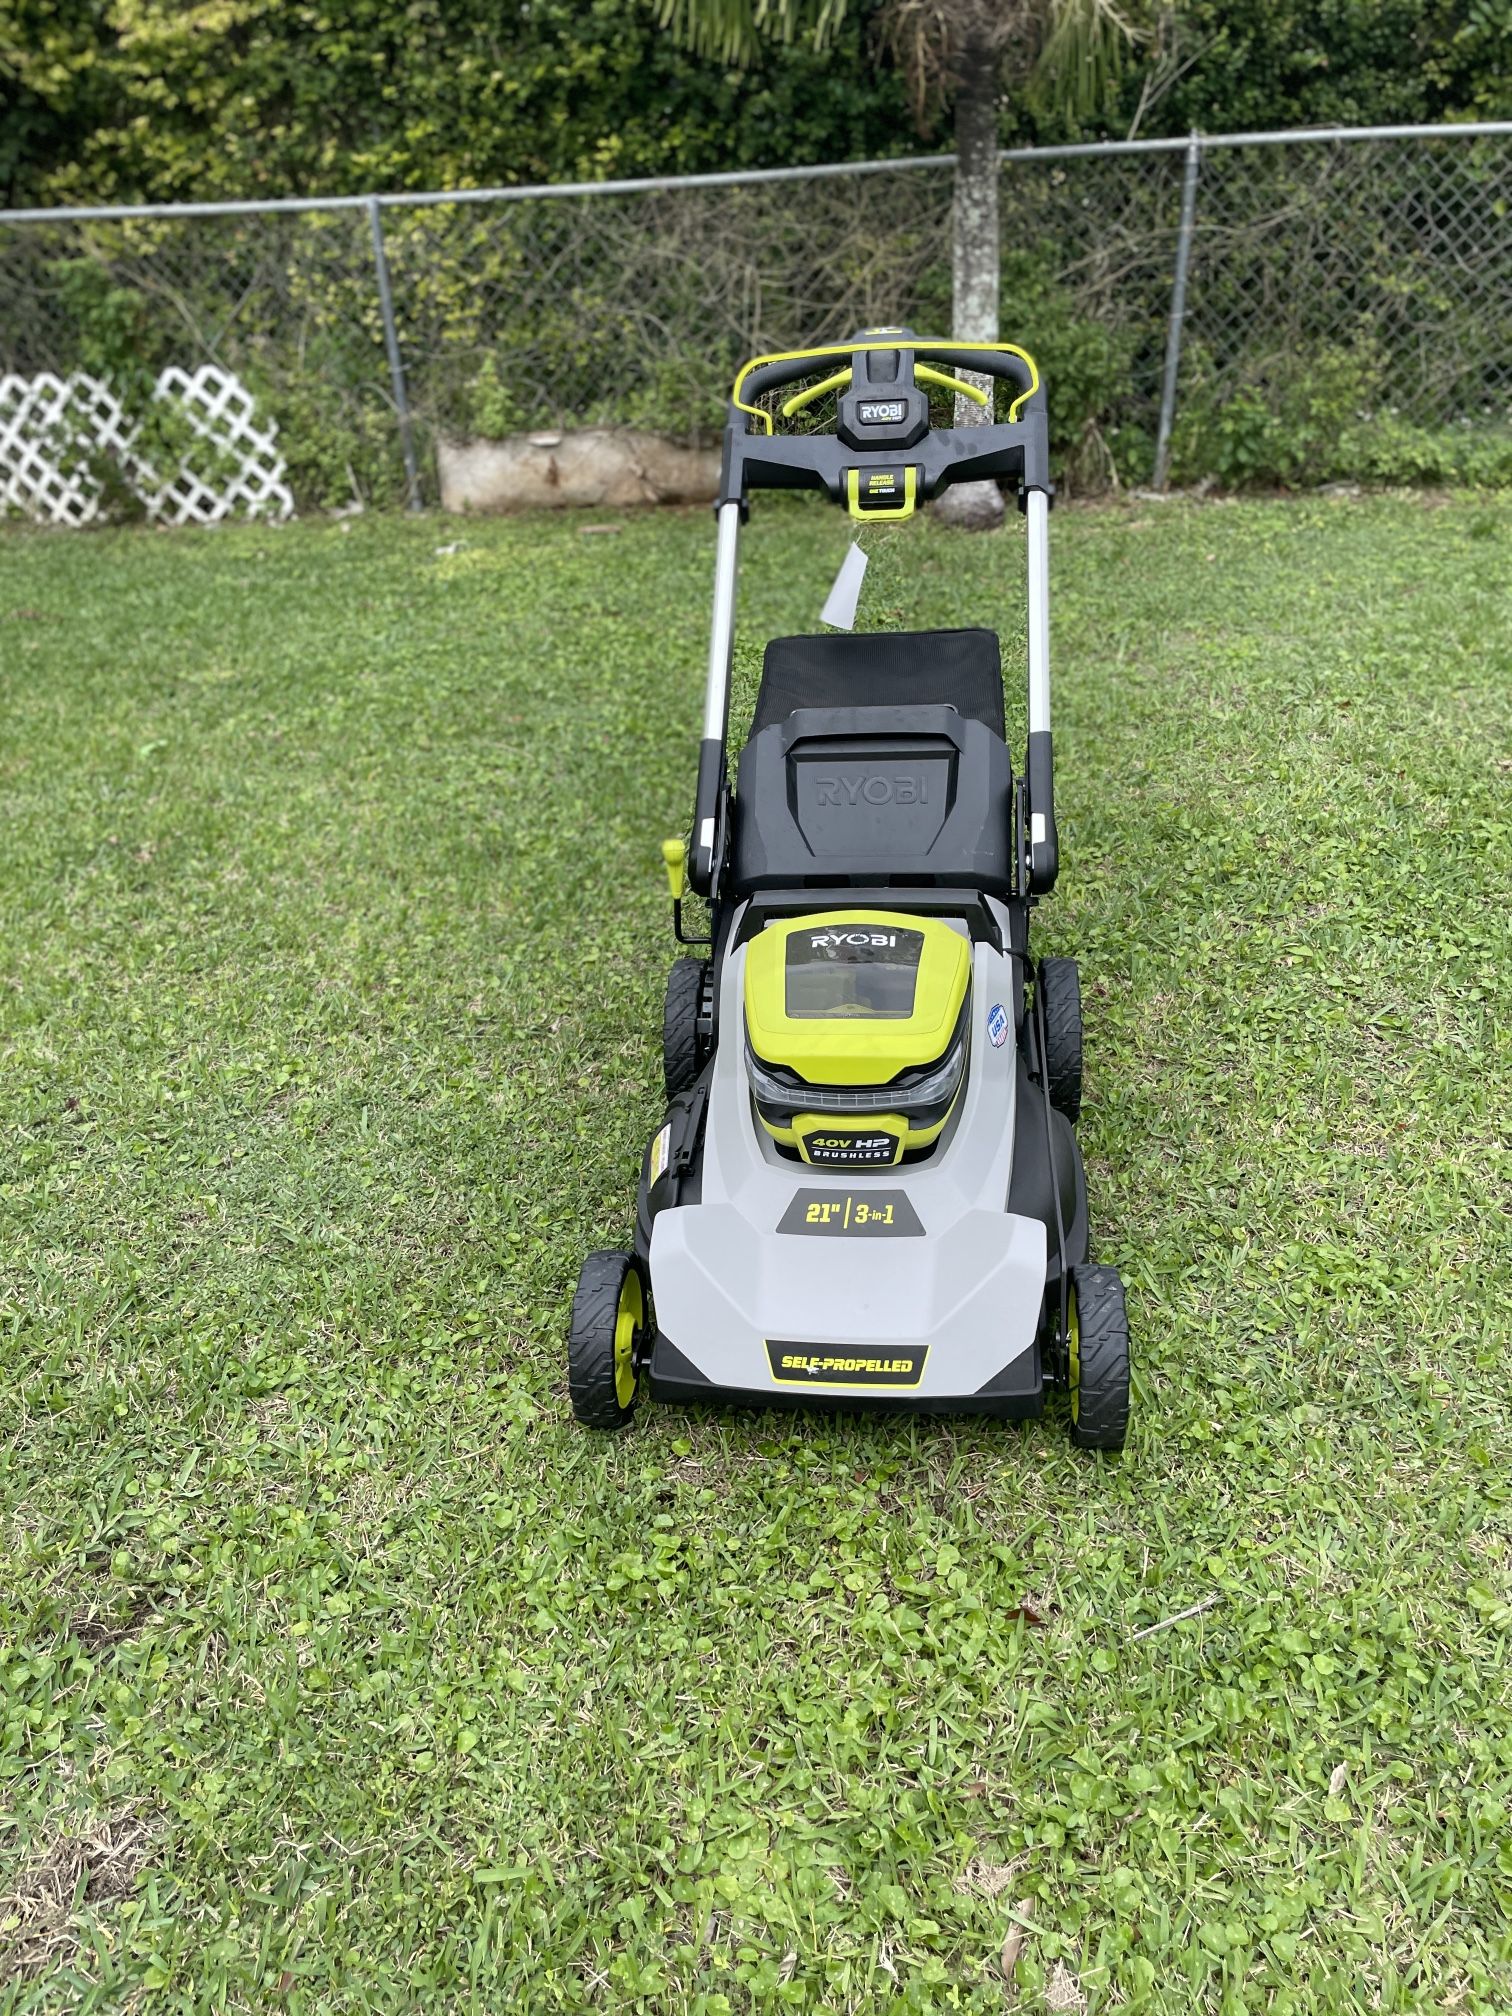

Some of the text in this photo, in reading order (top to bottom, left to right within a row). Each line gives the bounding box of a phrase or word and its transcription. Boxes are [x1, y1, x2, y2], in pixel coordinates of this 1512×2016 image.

[861, 403, 902, 418] RYOBI
[815, 776, 929, 806] RYOBI
[810, 933, 897, 948] RYOBI
[991, 1014, 1005, 1038] USA
[812, 1138, 890, 1148] 40V HP
[813, 1150, 890, 1159] BRUSHLESS
[805, 1203, 894, 1224] 21" 3-in-1
[781, 1355, 913, 1373] SELF-PROPELLED
